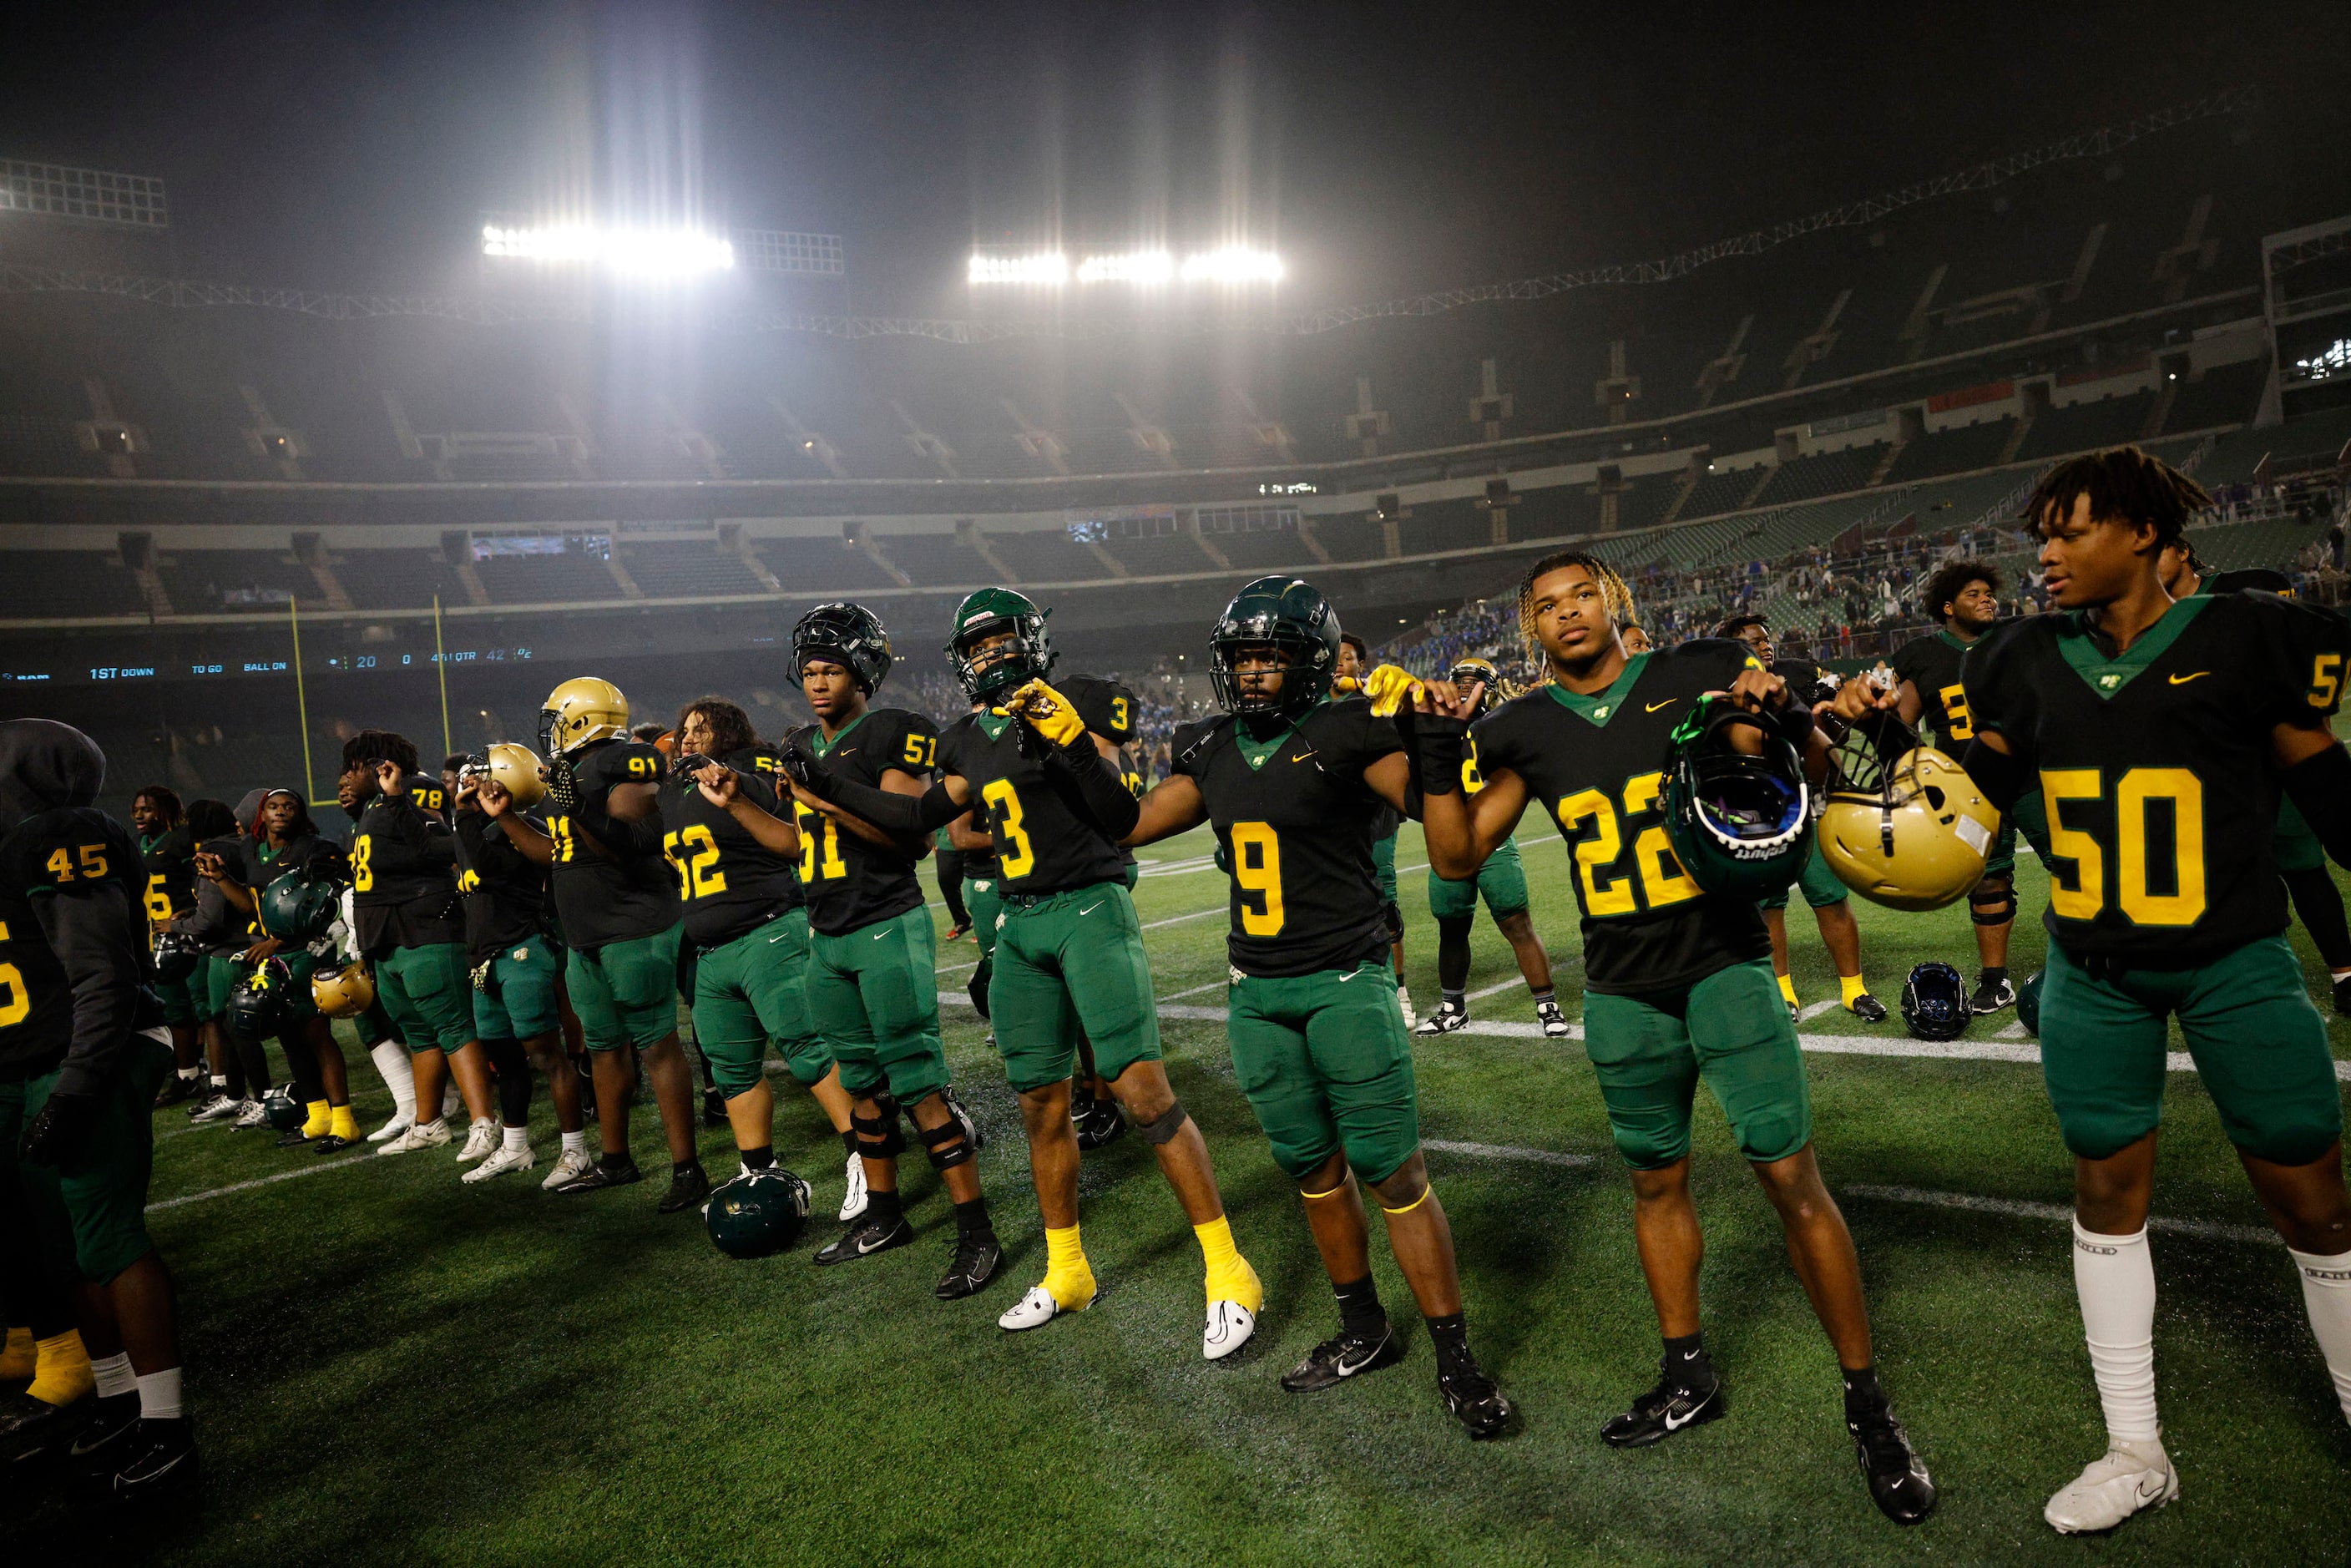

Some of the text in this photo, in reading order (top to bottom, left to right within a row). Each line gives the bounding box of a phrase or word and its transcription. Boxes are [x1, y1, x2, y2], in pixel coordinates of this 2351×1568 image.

[243, 661, 286, 671] BALL ON
[356, 655, 376, 668] 20
[455, 651, 476, 662] QTR
[486, 650, 504, 660] 42
[89, 668, 154, 680] 1ST DOWN
[191, 665, 223, 674] TO GO
[1110, 695, 1129, 731] 3
[903, 732, 936, 768] 51
[629, 757, 657, 779] 91
[412, 789, 442, 810] 78
[982, 777, 1034, 881] 3
[1557, 770, 1706, 918] 22
[2039, 766, 2208, 927] 50
[46, 843, 109, 883] 45
[1230, 819, 1284, 938] 9
